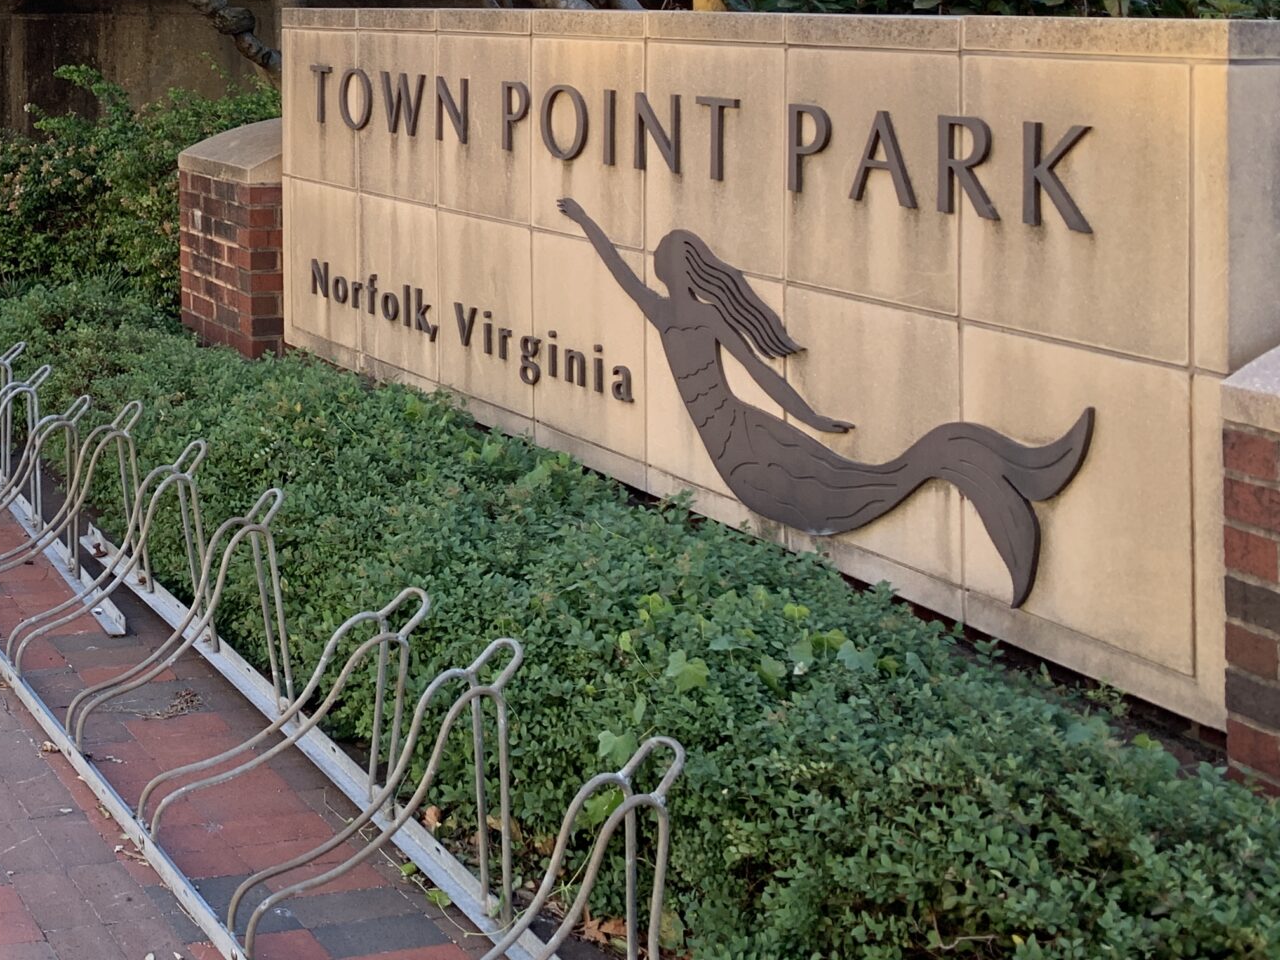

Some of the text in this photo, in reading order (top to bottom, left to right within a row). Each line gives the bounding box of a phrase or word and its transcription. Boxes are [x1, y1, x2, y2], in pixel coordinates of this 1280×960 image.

[310, 64, 1093, 234] TOWN POINT PARK
[311, 258, 635, 403] Norfolk, Virginia
